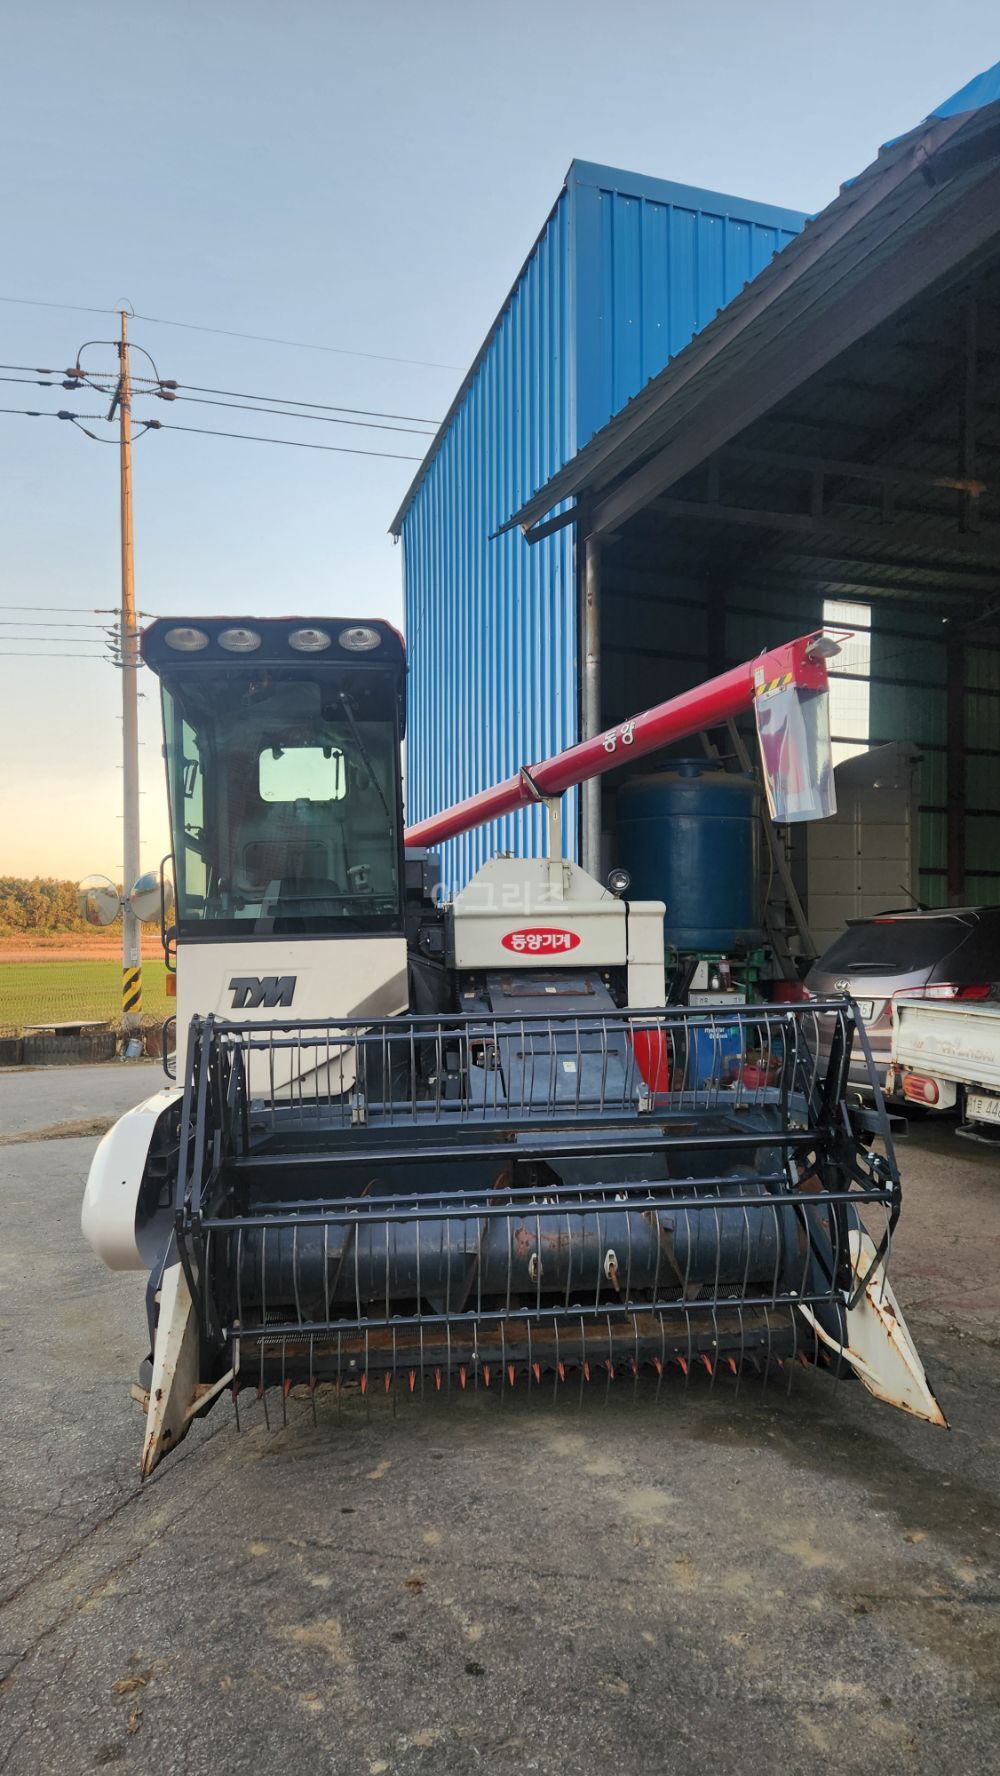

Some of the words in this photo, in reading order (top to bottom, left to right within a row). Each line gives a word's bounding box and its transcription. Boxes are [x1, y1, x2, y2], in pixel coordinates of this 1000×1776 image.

[602, 722, 635, 753] 동양
[510, 933, 571, 951] 동양기계
[228, 975, 297, 1009] TYM
